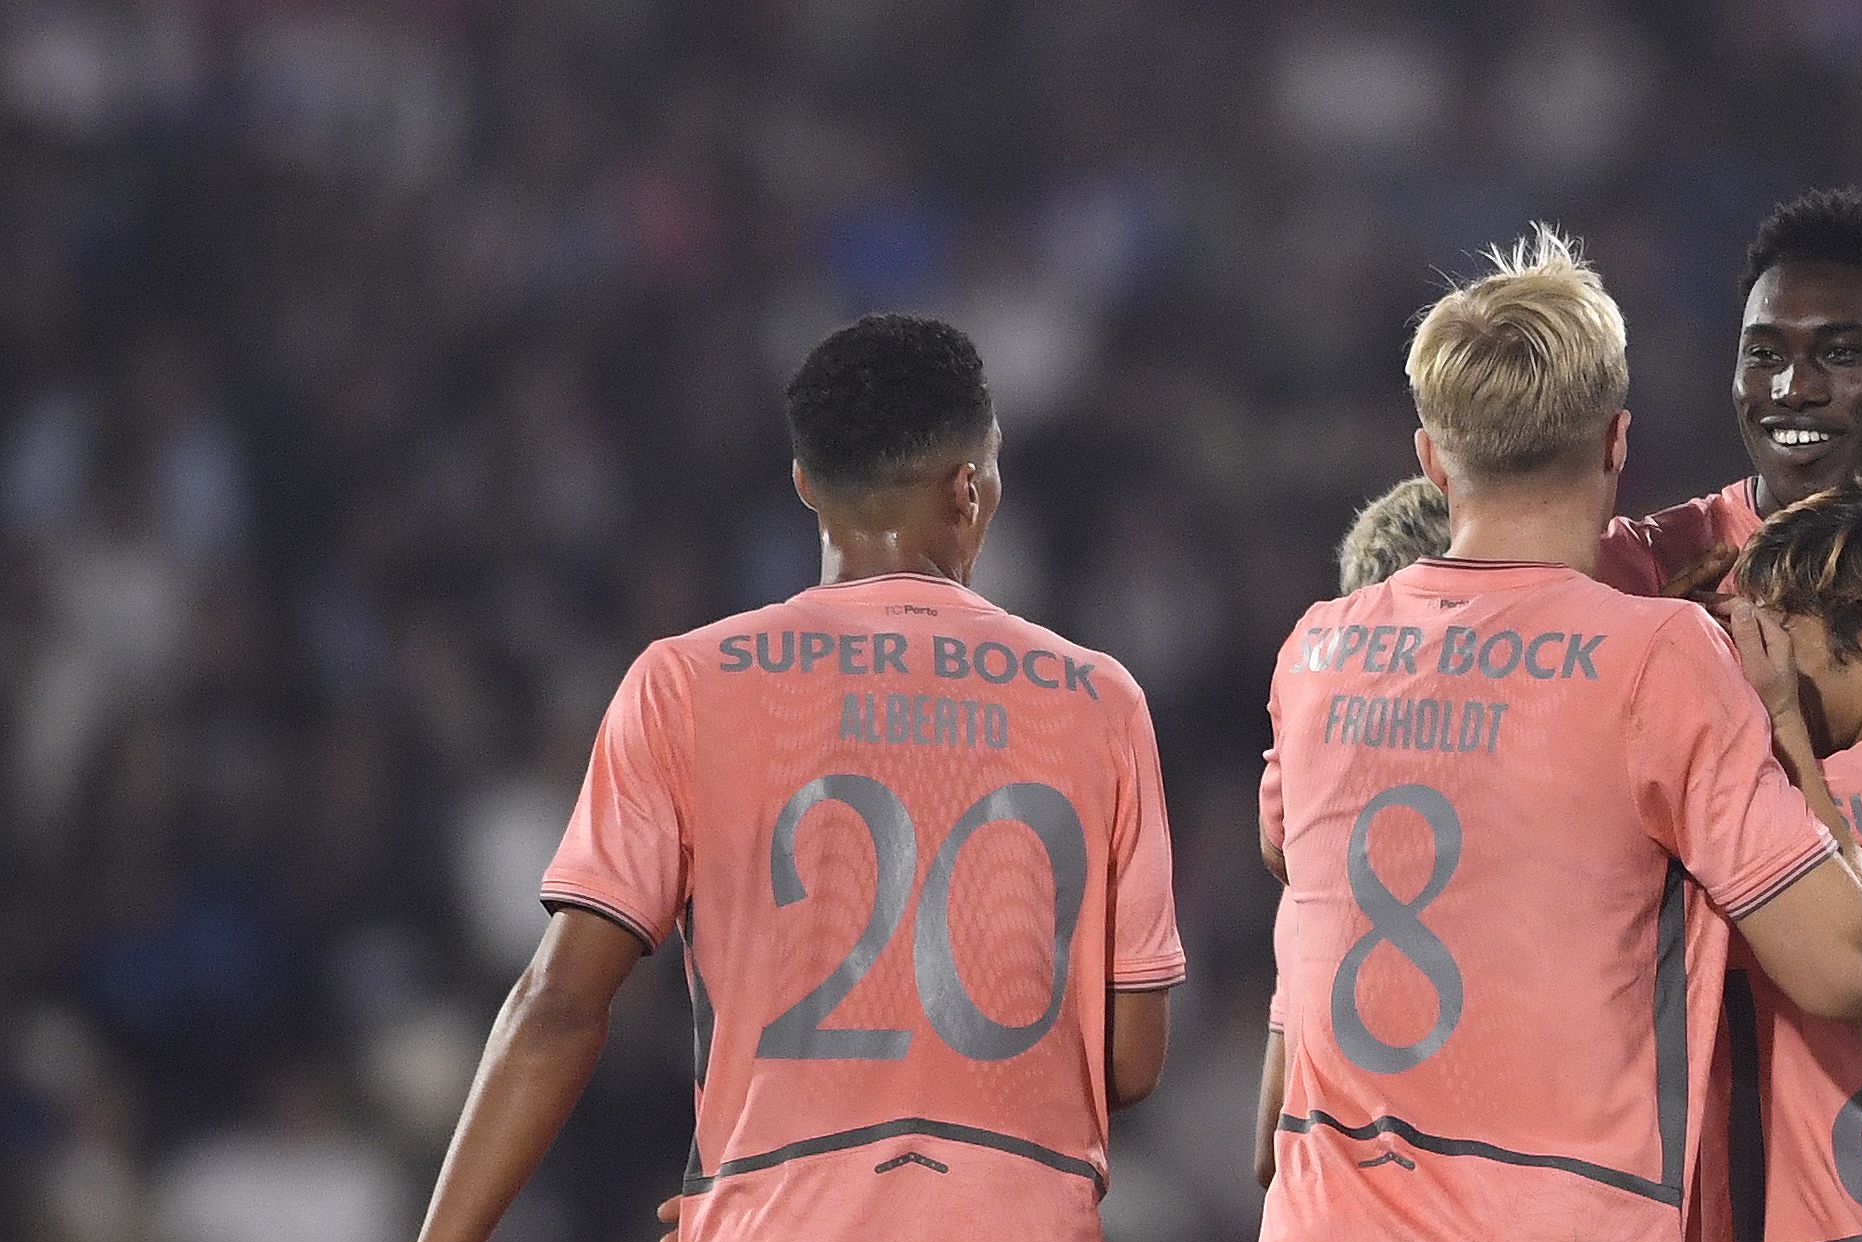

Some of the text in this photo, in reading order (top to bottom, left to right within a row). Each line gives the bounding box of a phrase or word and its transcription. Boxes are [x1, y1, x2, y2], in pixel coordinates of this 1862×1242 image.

[904, 604, 938, 617] Porto
[719, 630, 1100, 699] SUPER BOCK
[1291, 624, 1608, 680] SUPER BOCK
[838, 693, 1007, 750] ALBERTO
[1324, 695, 1509, 753] FROHOLDT
[756, 774, 1087, 1061] 20
[1331, 784, 1463, 1074] 8
